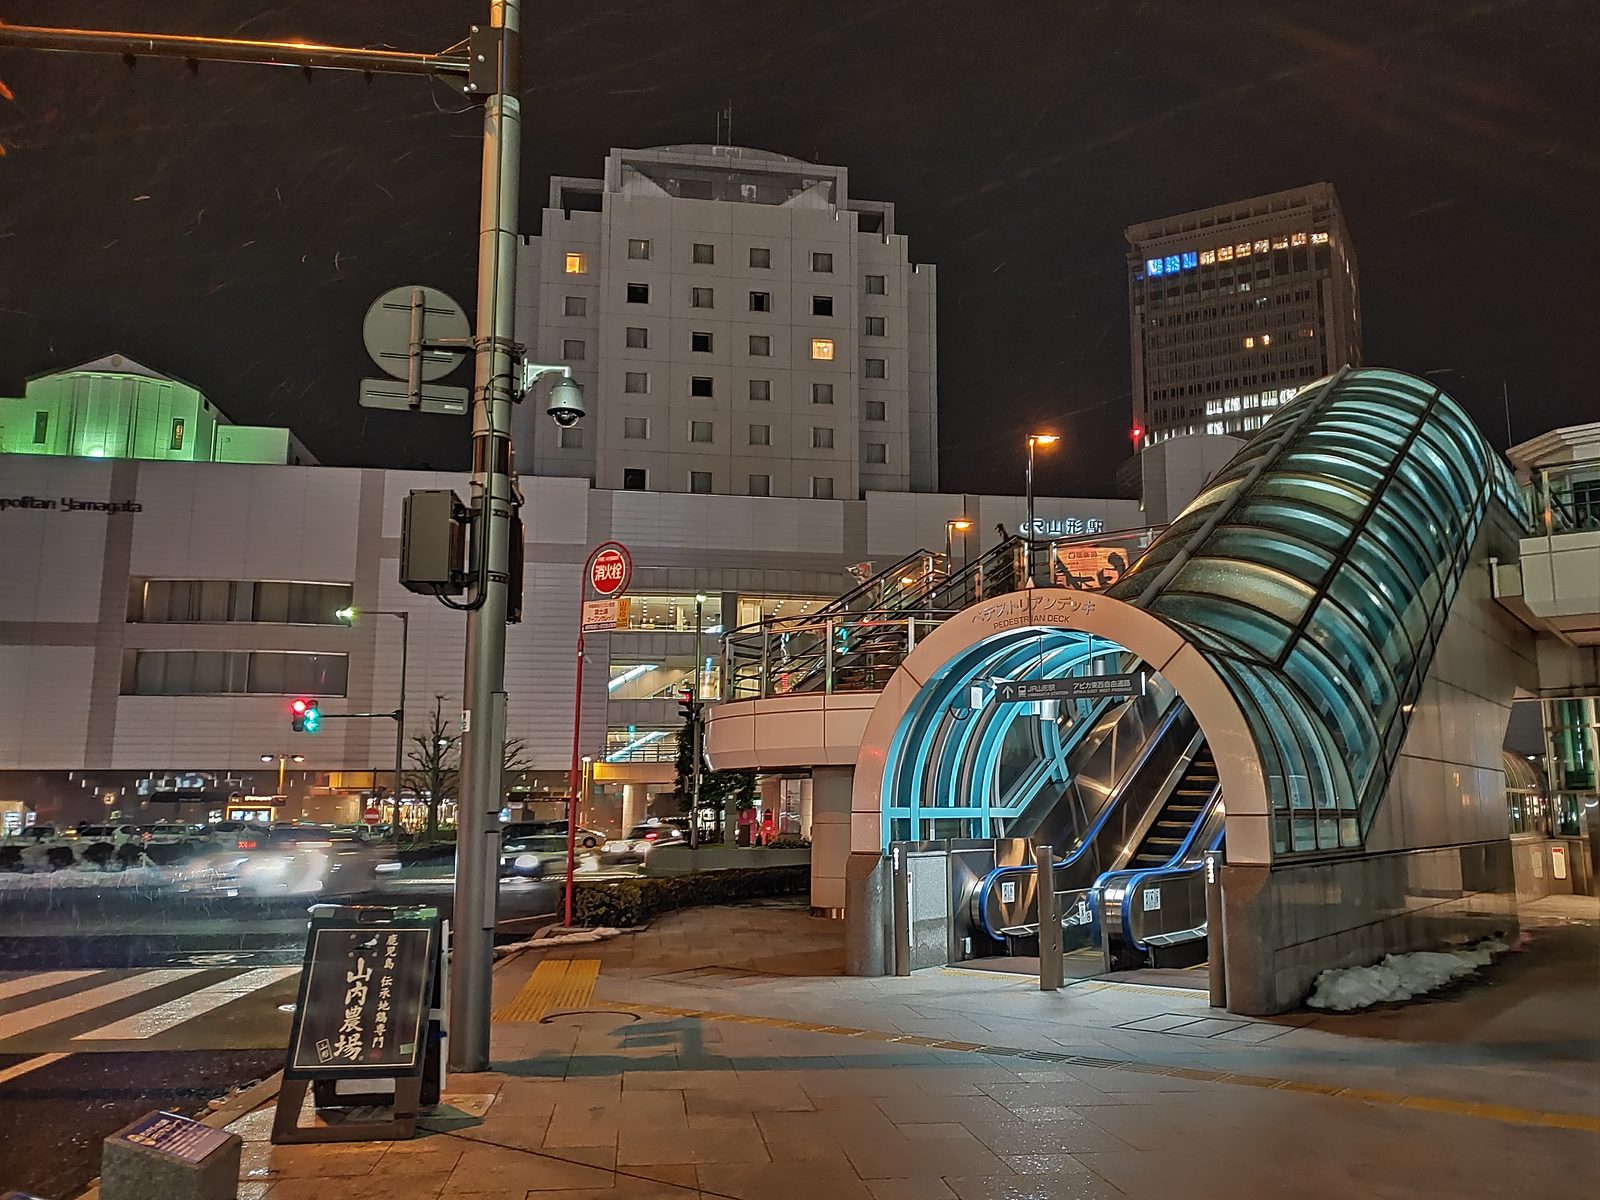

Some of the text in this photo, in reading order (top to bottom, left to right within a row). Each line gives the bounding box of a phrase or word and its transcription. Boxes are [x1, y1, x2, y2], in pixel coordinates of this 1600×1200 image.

[60, 497, 143, 515] Yamagata
[595, 563, 622, 581] 消火栓
[993, 614, 1070, 630] PEDESTRIAN DECK
[384, 934, 399, 970] 鹿児島
[333, 957, 373, 1061] 山内農場
